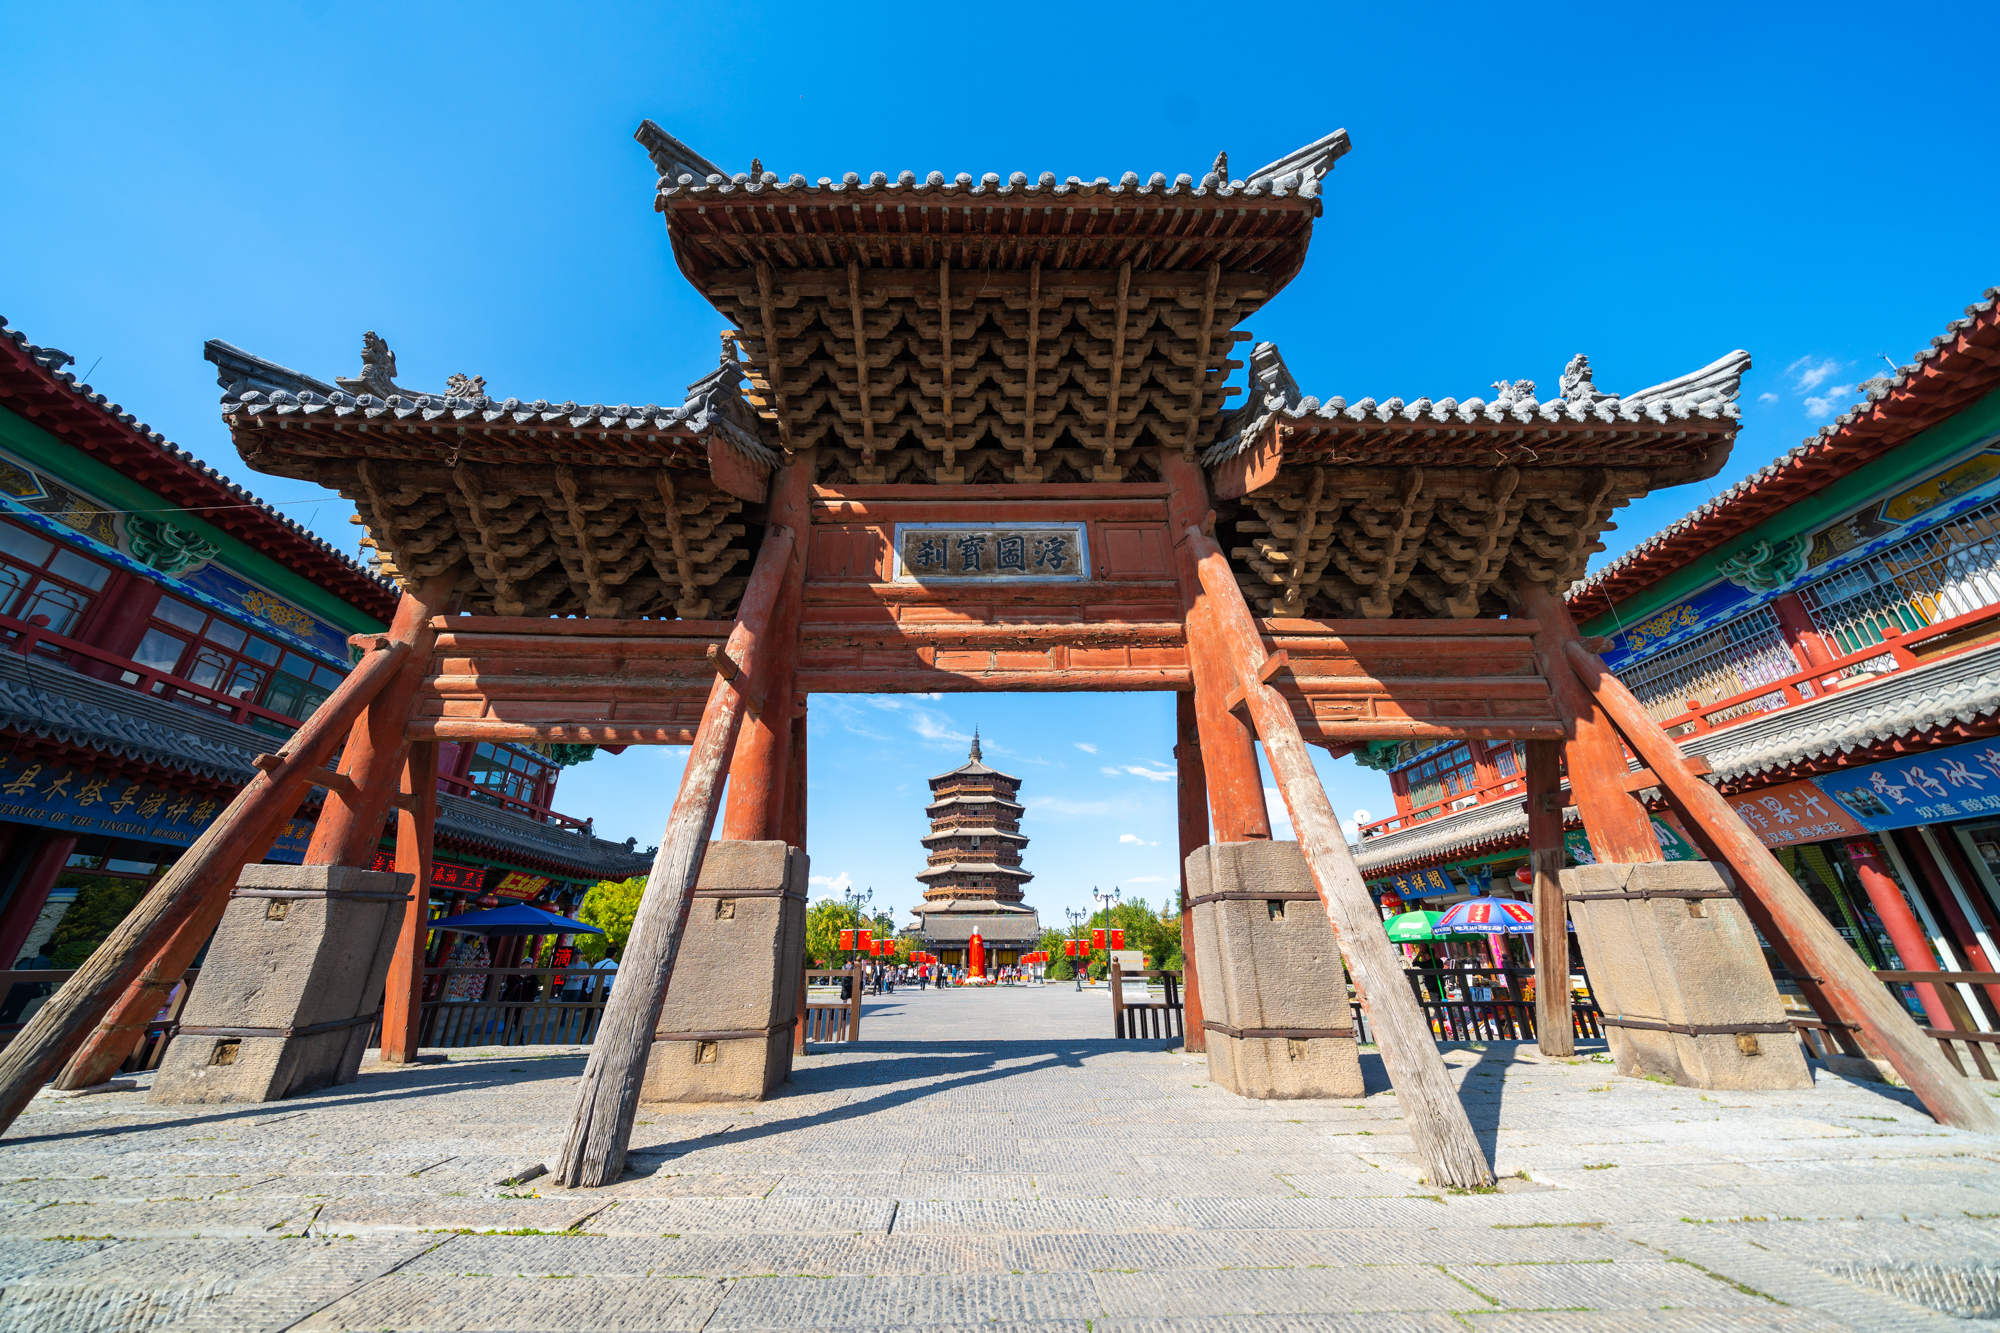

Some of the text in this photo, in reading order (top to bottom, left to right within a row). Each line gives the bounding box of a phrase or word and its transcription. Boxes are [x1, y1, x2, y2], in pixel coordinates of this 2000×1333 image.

[0, 757, 216, 830] 县木塔导游讲解
[0, 803, 48, 819] ERVICE
[50, 812, 67, 823] OF
[69, 816, 95, 827] THE
[100, 820, 149, 835] YINGXIAN
[151, 828, 189, 841] WOODEN
